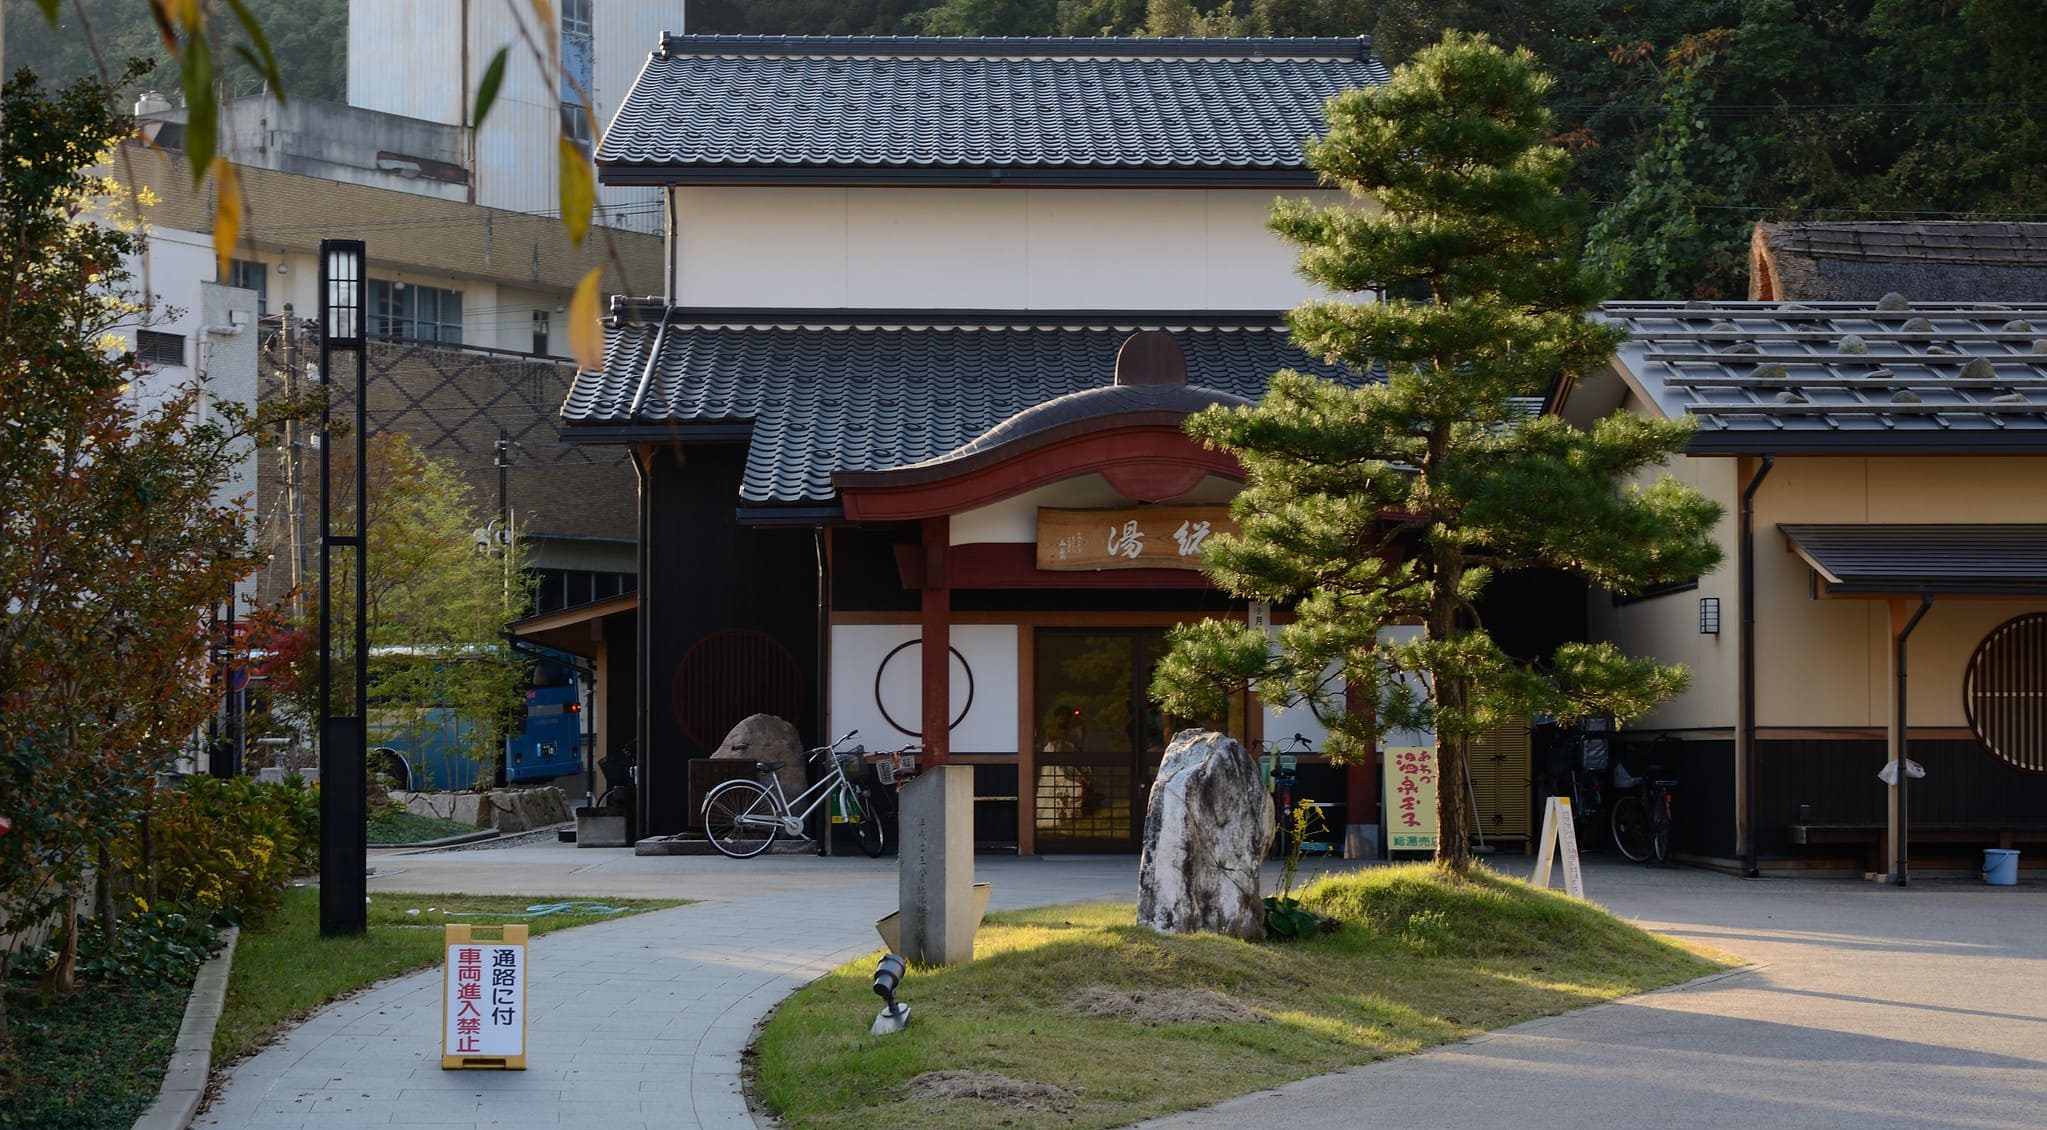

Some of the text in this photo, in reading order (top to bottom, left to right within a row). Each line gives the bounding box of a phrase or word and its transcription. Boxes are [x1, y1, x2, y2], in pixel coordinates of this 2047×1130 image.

[456, 948, 482, 1053] 車両進入禁止
[491, 949, 516, 1025] 通路に付
